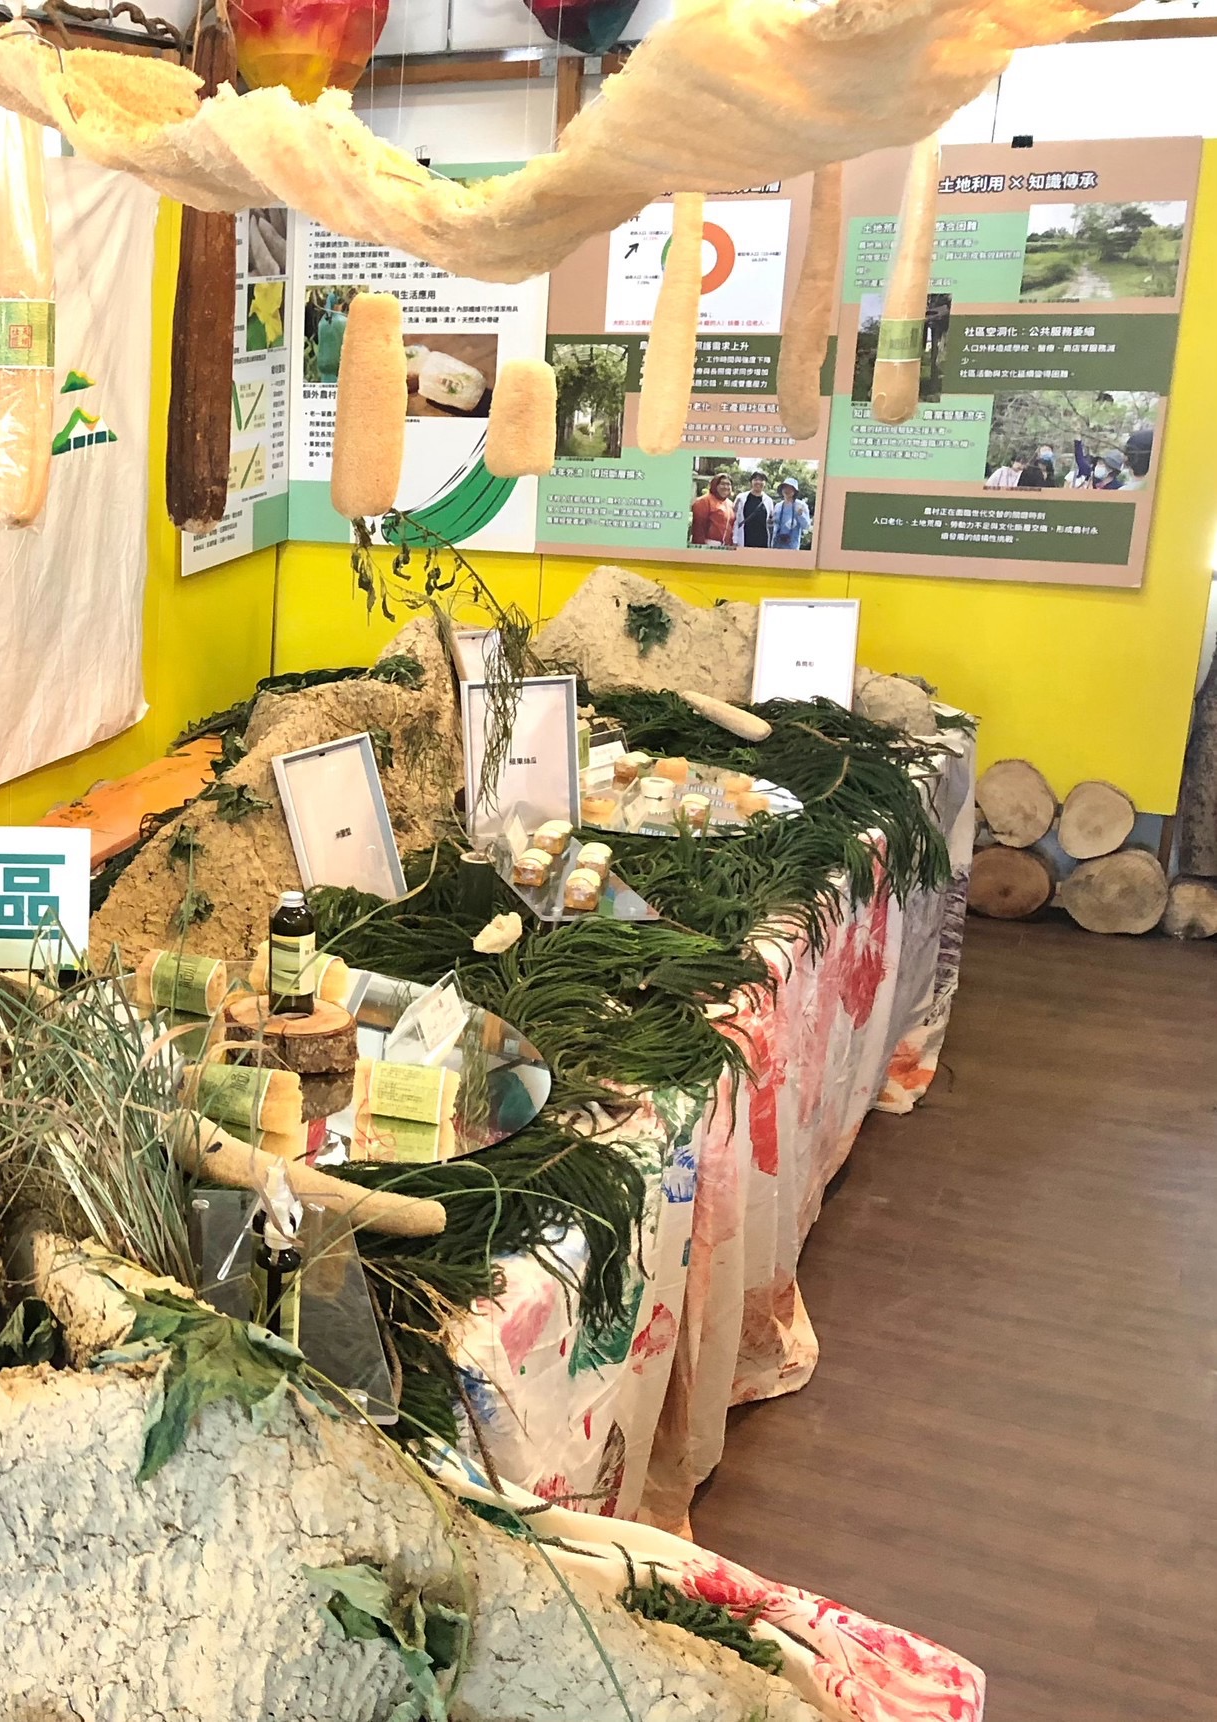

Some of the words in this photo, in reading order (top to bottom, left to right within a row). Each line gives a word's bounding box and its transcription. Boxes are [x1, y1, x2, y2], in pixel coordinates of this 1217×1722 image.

[939, 175, 1003, 194] 土地利用
[1029, 170, 1097, 191] 知識傳承
